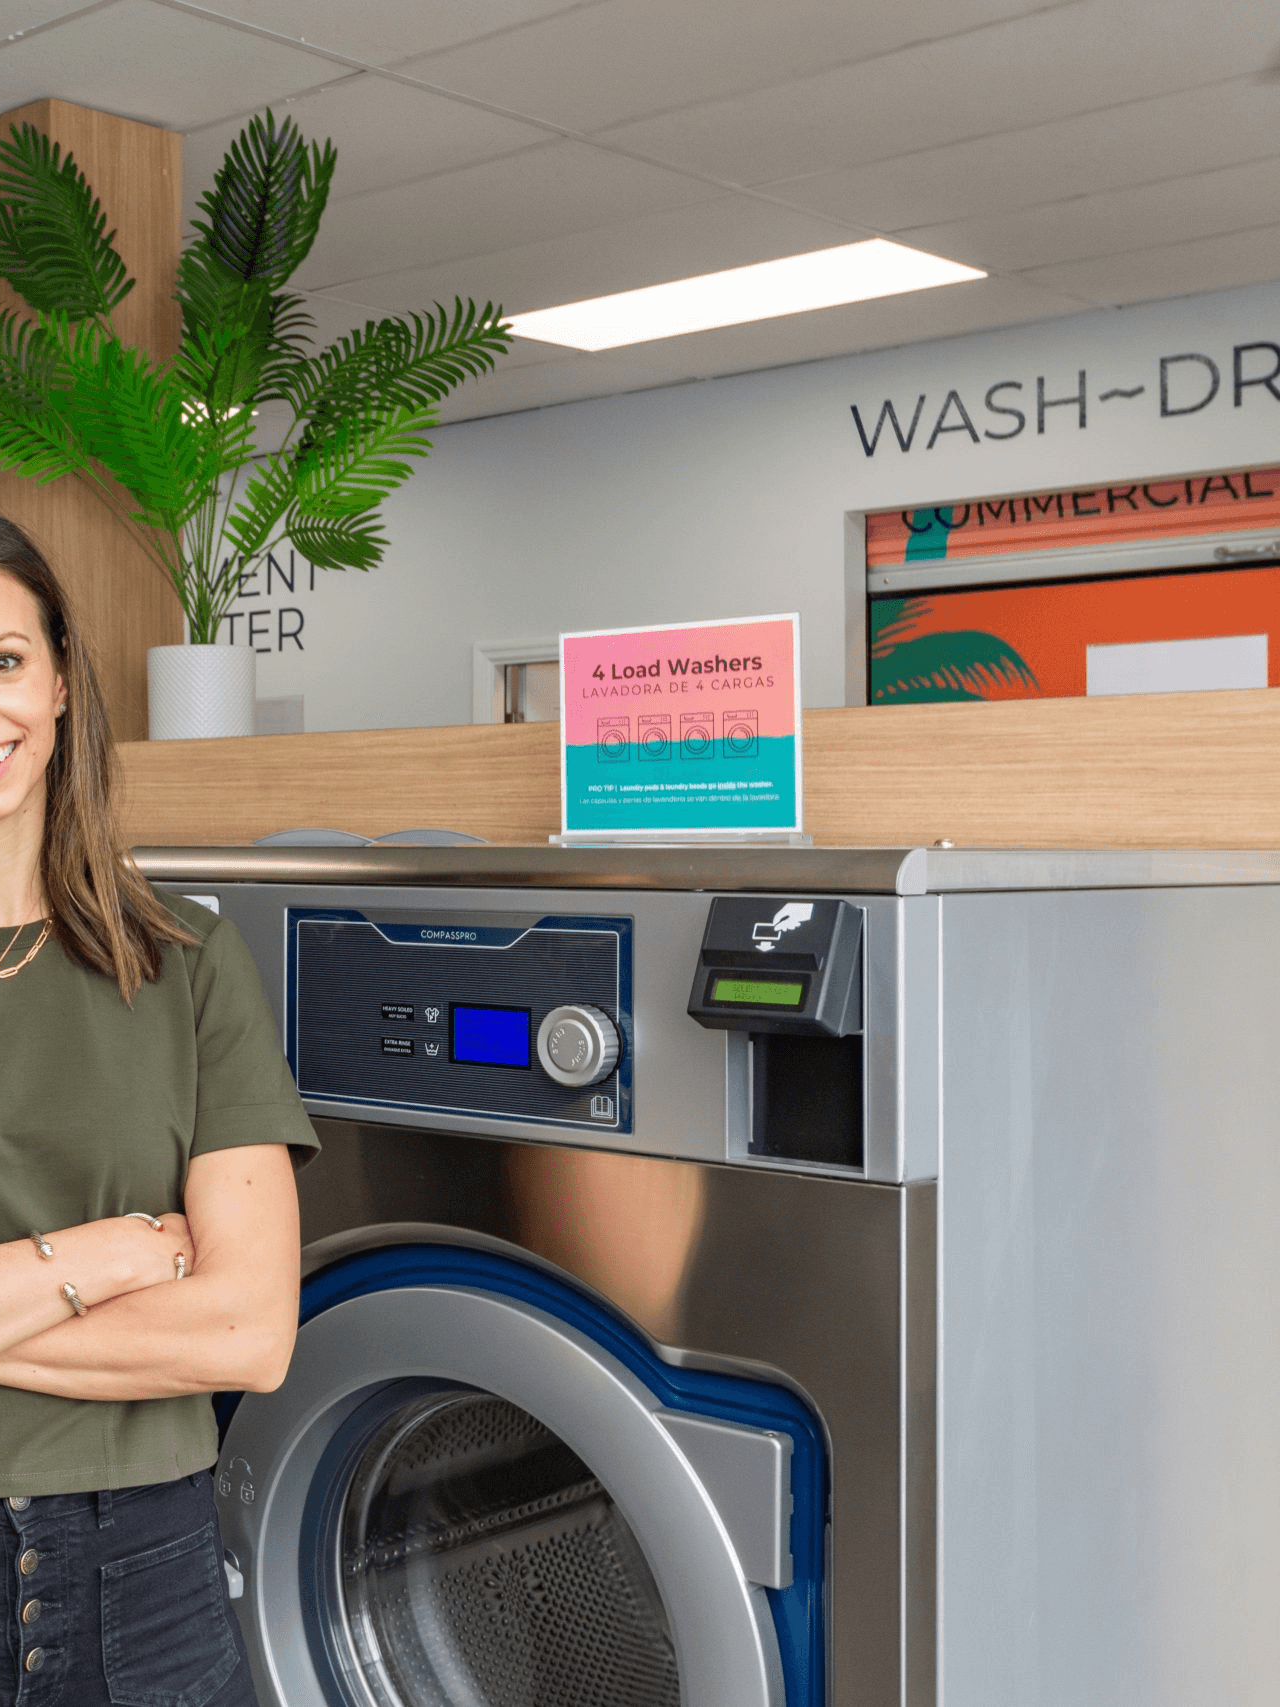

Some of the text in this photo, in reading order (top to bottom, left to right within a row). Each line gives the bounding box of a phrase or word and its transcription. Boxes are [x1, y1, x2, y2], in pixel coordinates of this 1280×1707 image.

[592, 654, 763, 681] 4 Load Washers
[582, 675, 775, 699] LAVADORA DE 4 CARGAS
[420, 929, 477, 941] COMPASSPRO
